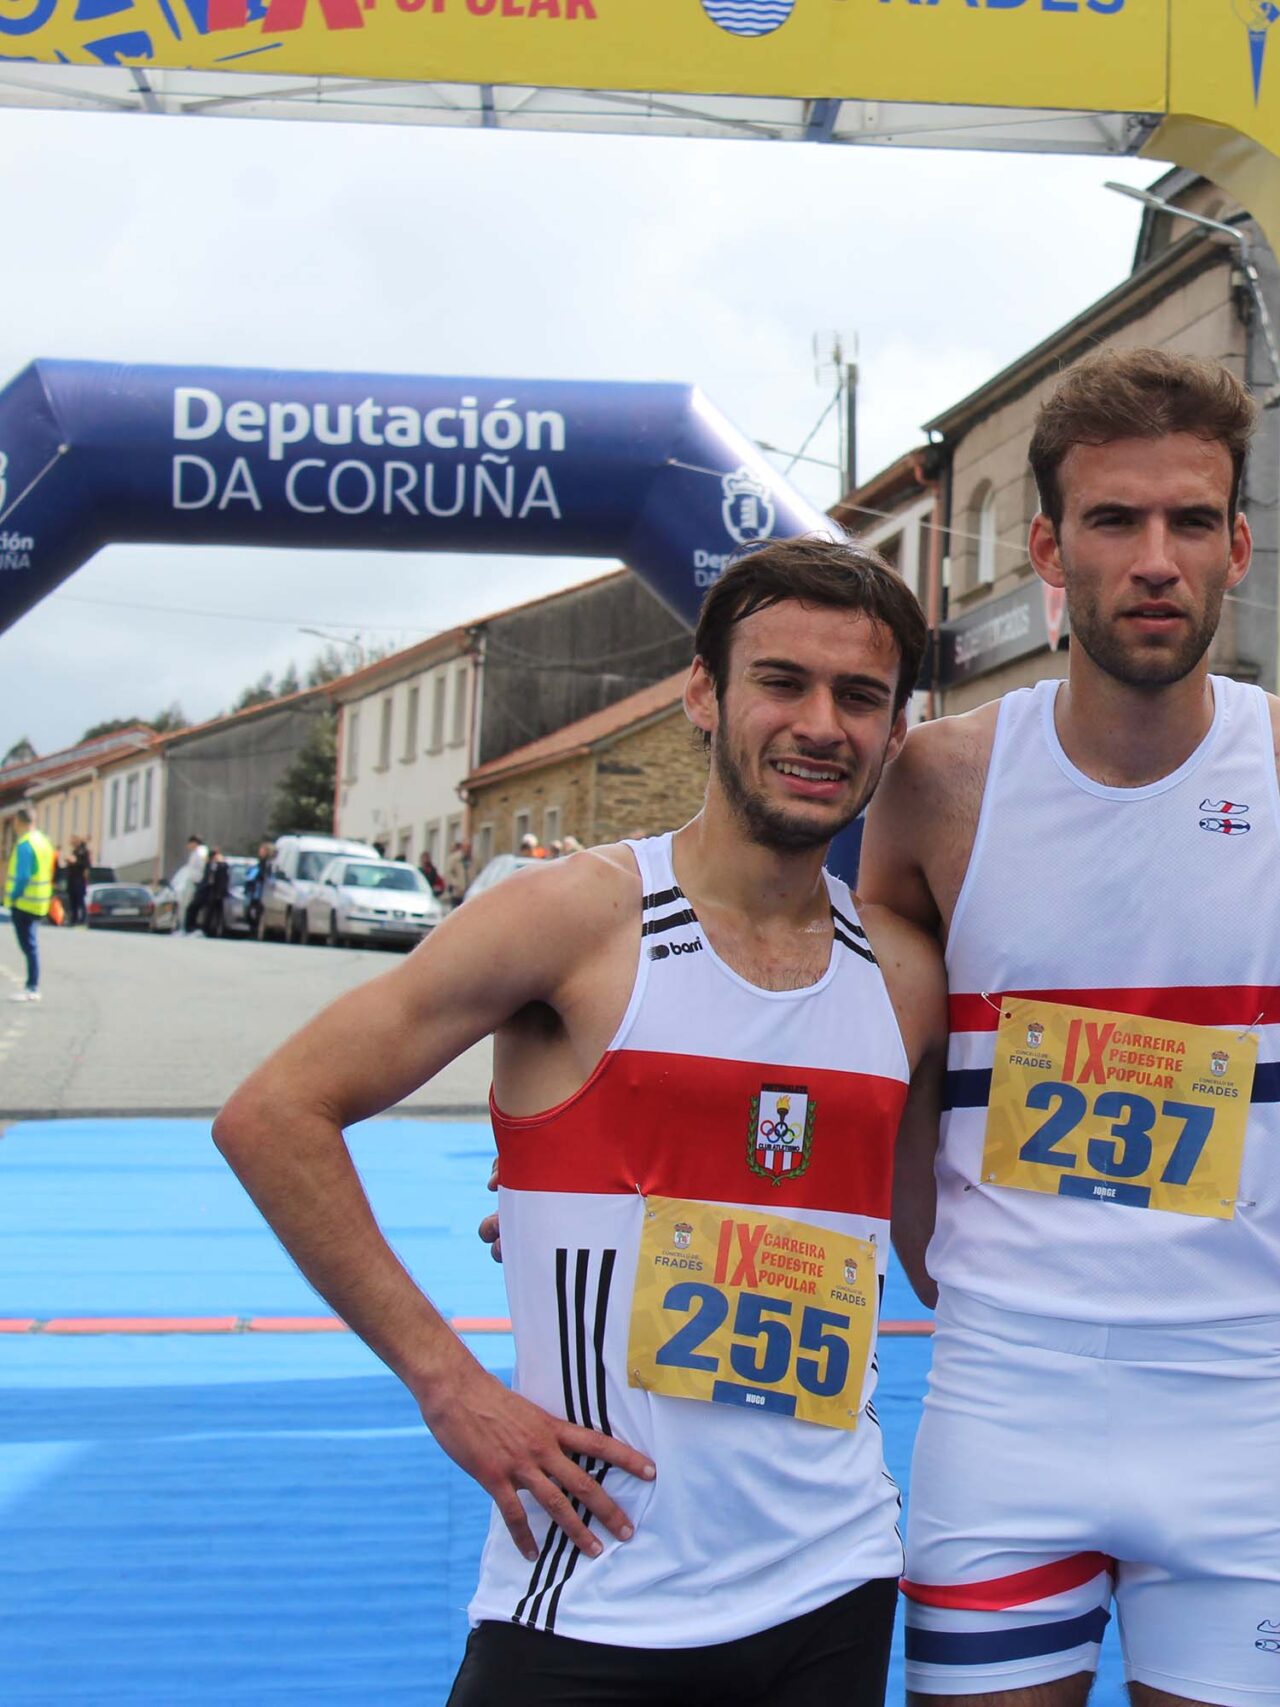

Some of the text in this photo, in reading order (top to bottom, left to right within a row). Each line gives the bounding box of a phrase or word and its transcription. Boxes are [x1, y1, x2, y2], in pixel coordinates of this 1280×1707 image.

[173, 387, 565, 460] Deputación
[172, 453, 562, 520] DA CORUÑA
[1061, 1018, 1116, 1085] IX
[1112, 1031, 1186, 1055] CARREIRA
[1009, 1055, 1052, 1069] FRADES
[1109, 1048, 1183, 1072] PEDESTRE
[1106, 1066, 1174, 1089] POPULAR
[1192, 1082, 1238, 1098] FRADES
[1019, 1081, 1215, 1186] 237
[713, 1219, 768, 1288] IX
[763, 1232, 826, 1260] CARREIRA
[654, 1256, 704, 1271] FRADES
[761, 1252, 824, 1278] PEDESTRE
[758, 1270, 817, 1295] POPULAR
[831, 1290, 866, 1307] FRADES
[656, 1281, 850, 1398] 255
[746, 1392, 766, 1405] HUGO
